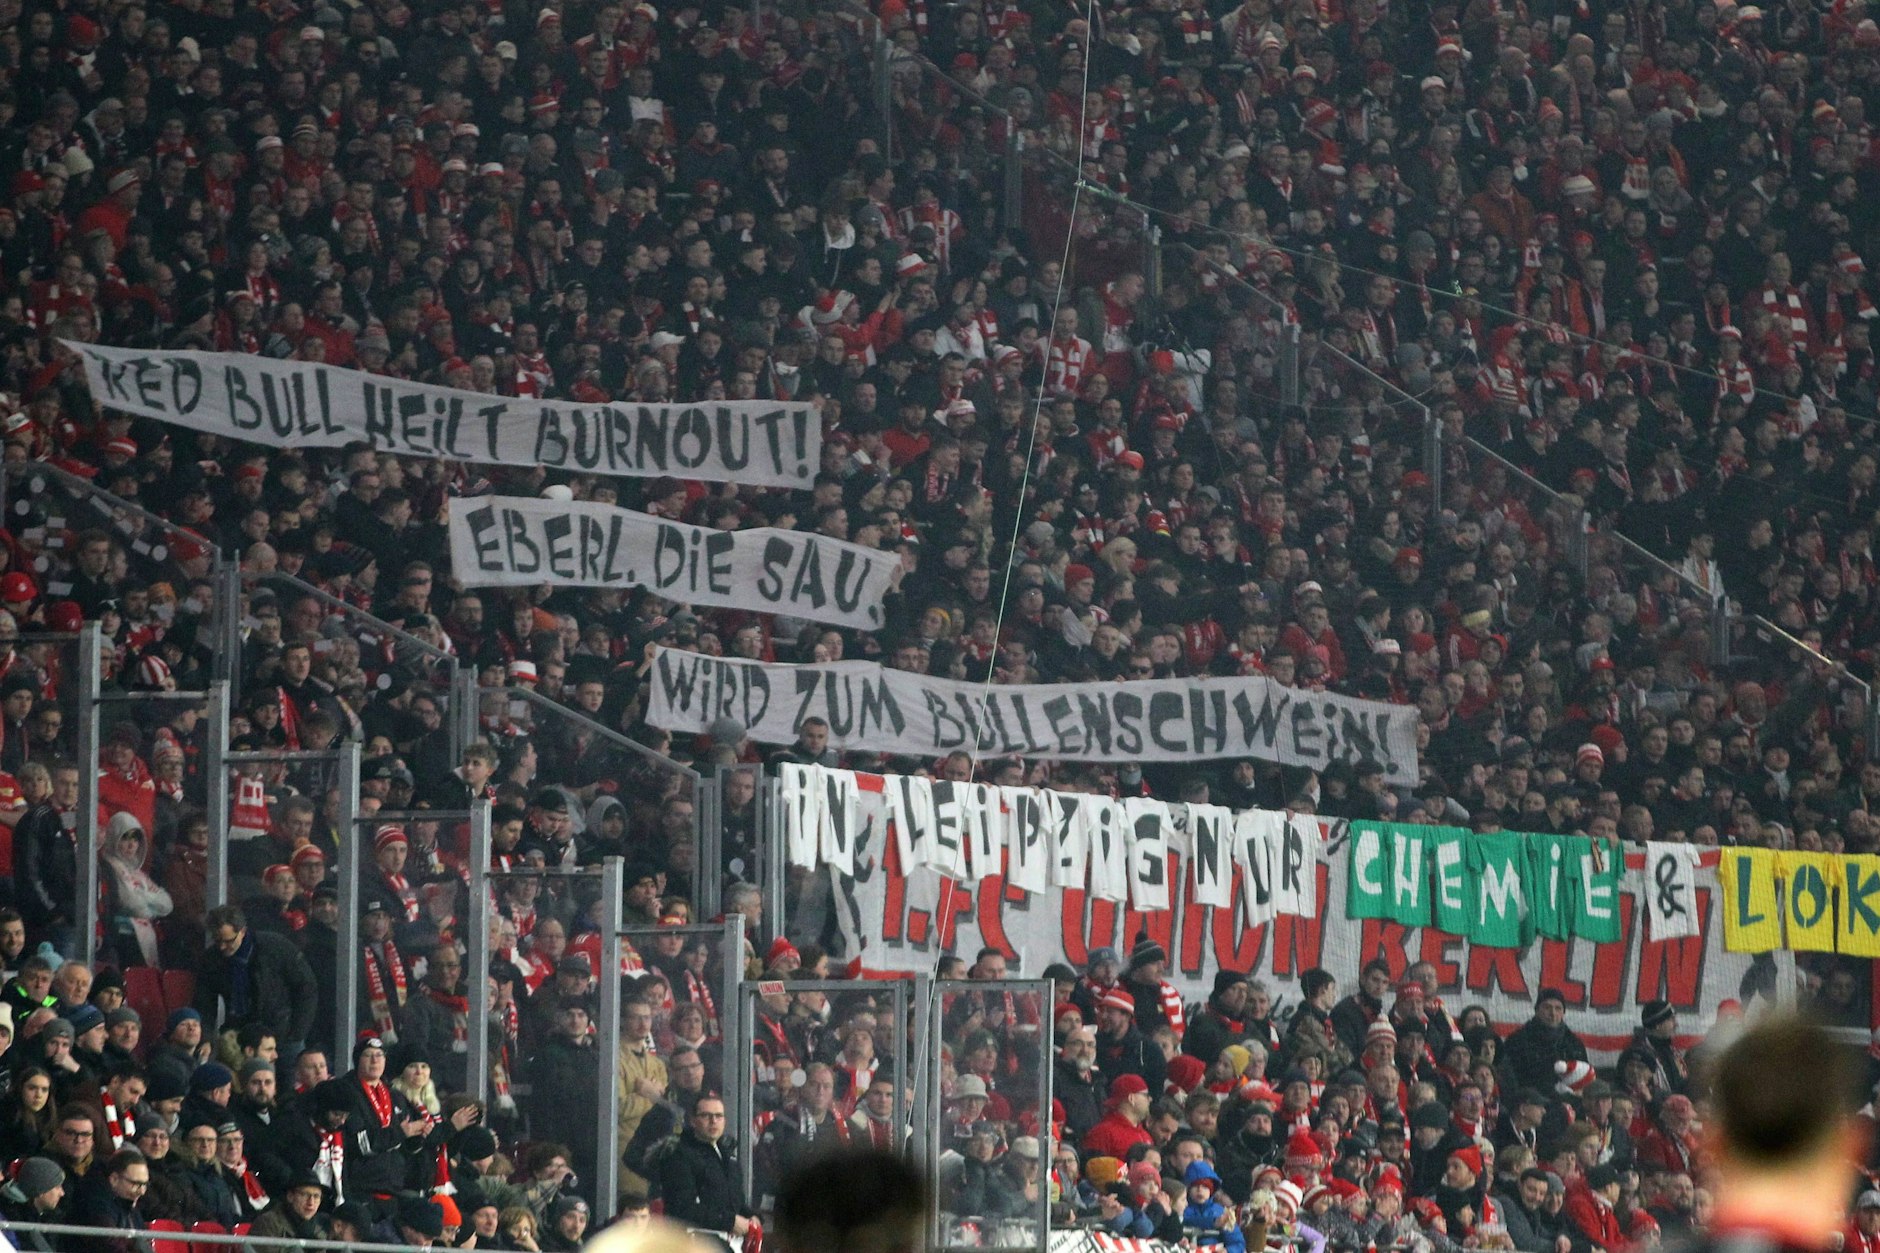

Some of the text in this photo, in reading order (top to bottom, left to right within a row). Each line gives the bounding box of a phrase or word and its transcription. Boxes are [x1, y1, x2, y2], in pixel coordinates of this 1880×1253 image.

[83, 349, 202, 415] RED
[225, 366, 345, 437] BULL
[534, 405, 809, 479] BURNOUT!
[793, 668, 906, 739] ZUM
[1656, 853, 1687, 919] &
[1737, 856, 1880, 936] LOK
